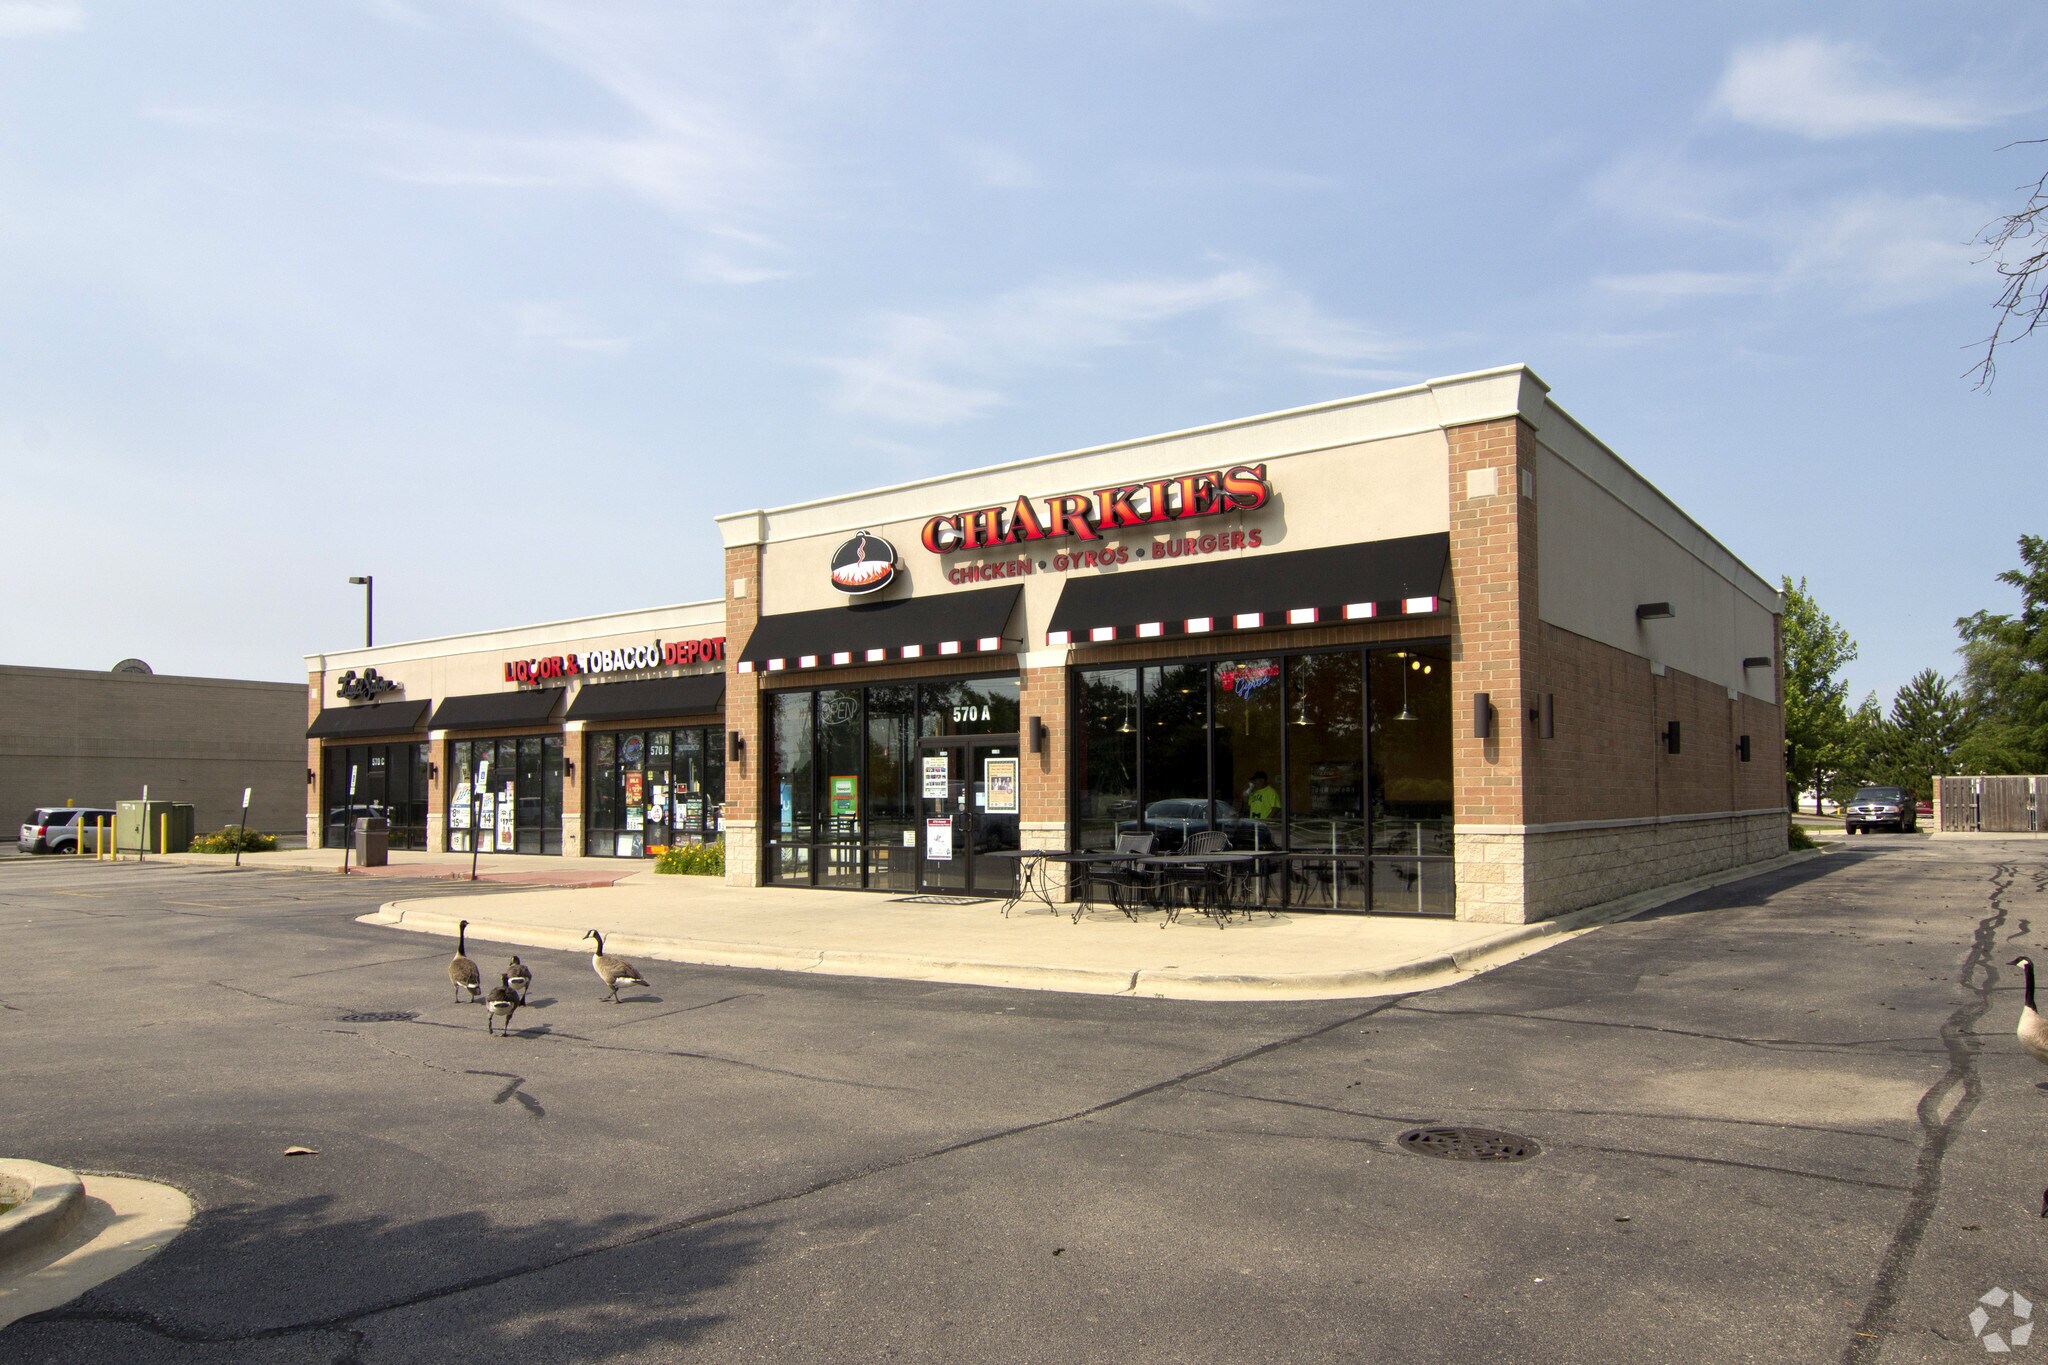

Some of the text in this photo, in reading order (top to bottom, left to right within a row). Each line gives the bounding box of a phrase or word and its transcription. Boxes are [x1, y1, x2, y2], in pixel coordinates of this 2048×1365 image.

[921, 463, 1269, 554] CHARKIES
[948, 528, 1263, 585] CHICKEN GYROS BURGERS
[566, 653, 580, 676] &
[579, 640, 661, 675] TOBACCO
[664, 636, 727, 666] DEPOT
[1235, 675, 1270, 700] Gyros
[821, 700, 857, 720] OPEN
[953, 704, 991, 722] 570 A
[650, 745, 663, 756] 570
[664, 745, 670, 755] B
